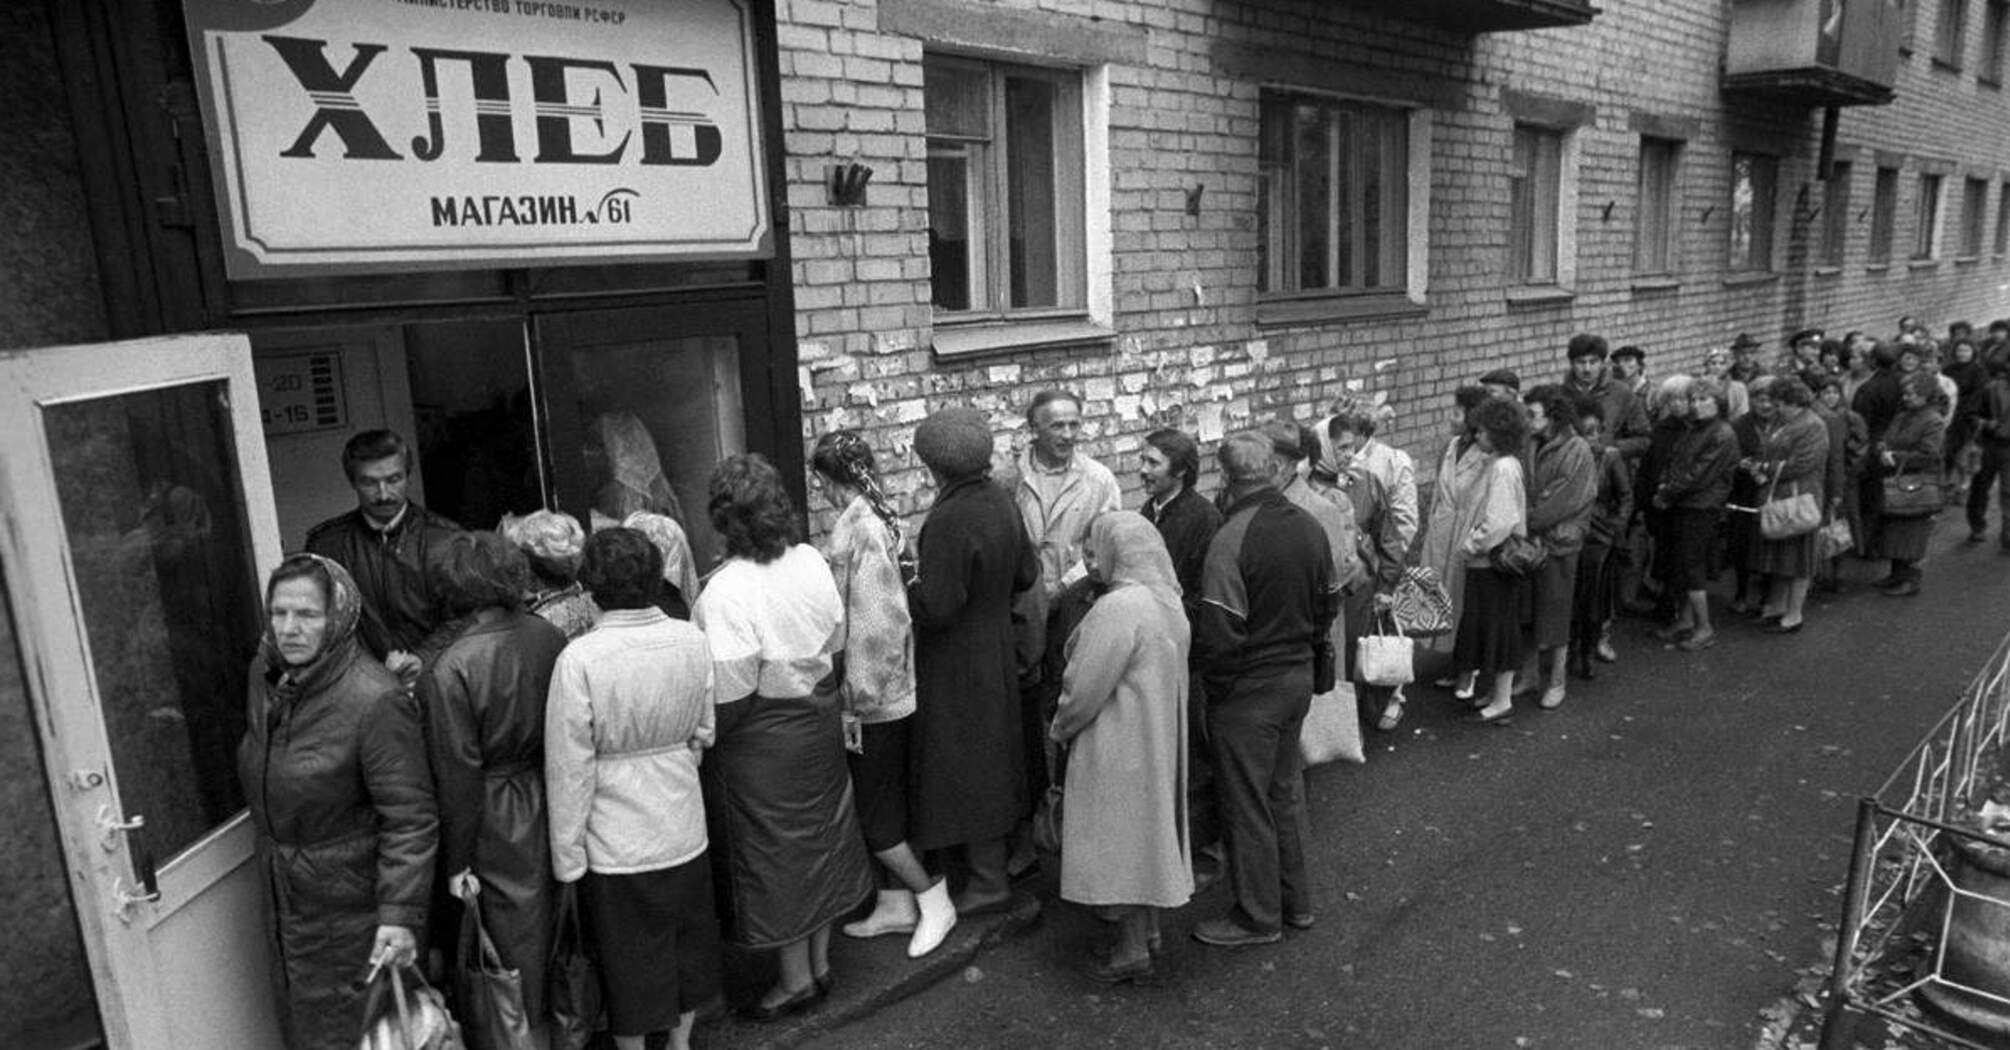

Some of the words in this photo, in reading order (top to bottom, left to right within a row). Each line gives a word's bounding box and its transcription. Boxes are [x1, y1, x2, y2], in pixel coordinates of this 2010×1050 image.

[515, 1, 580, 20] ТОРГОВЛИ
[584, 8, 625, 23] РСФСР
[262, 35, 721, 166] ХЛЕБ
[431, 196, 577, 227] МАГАЗИН
